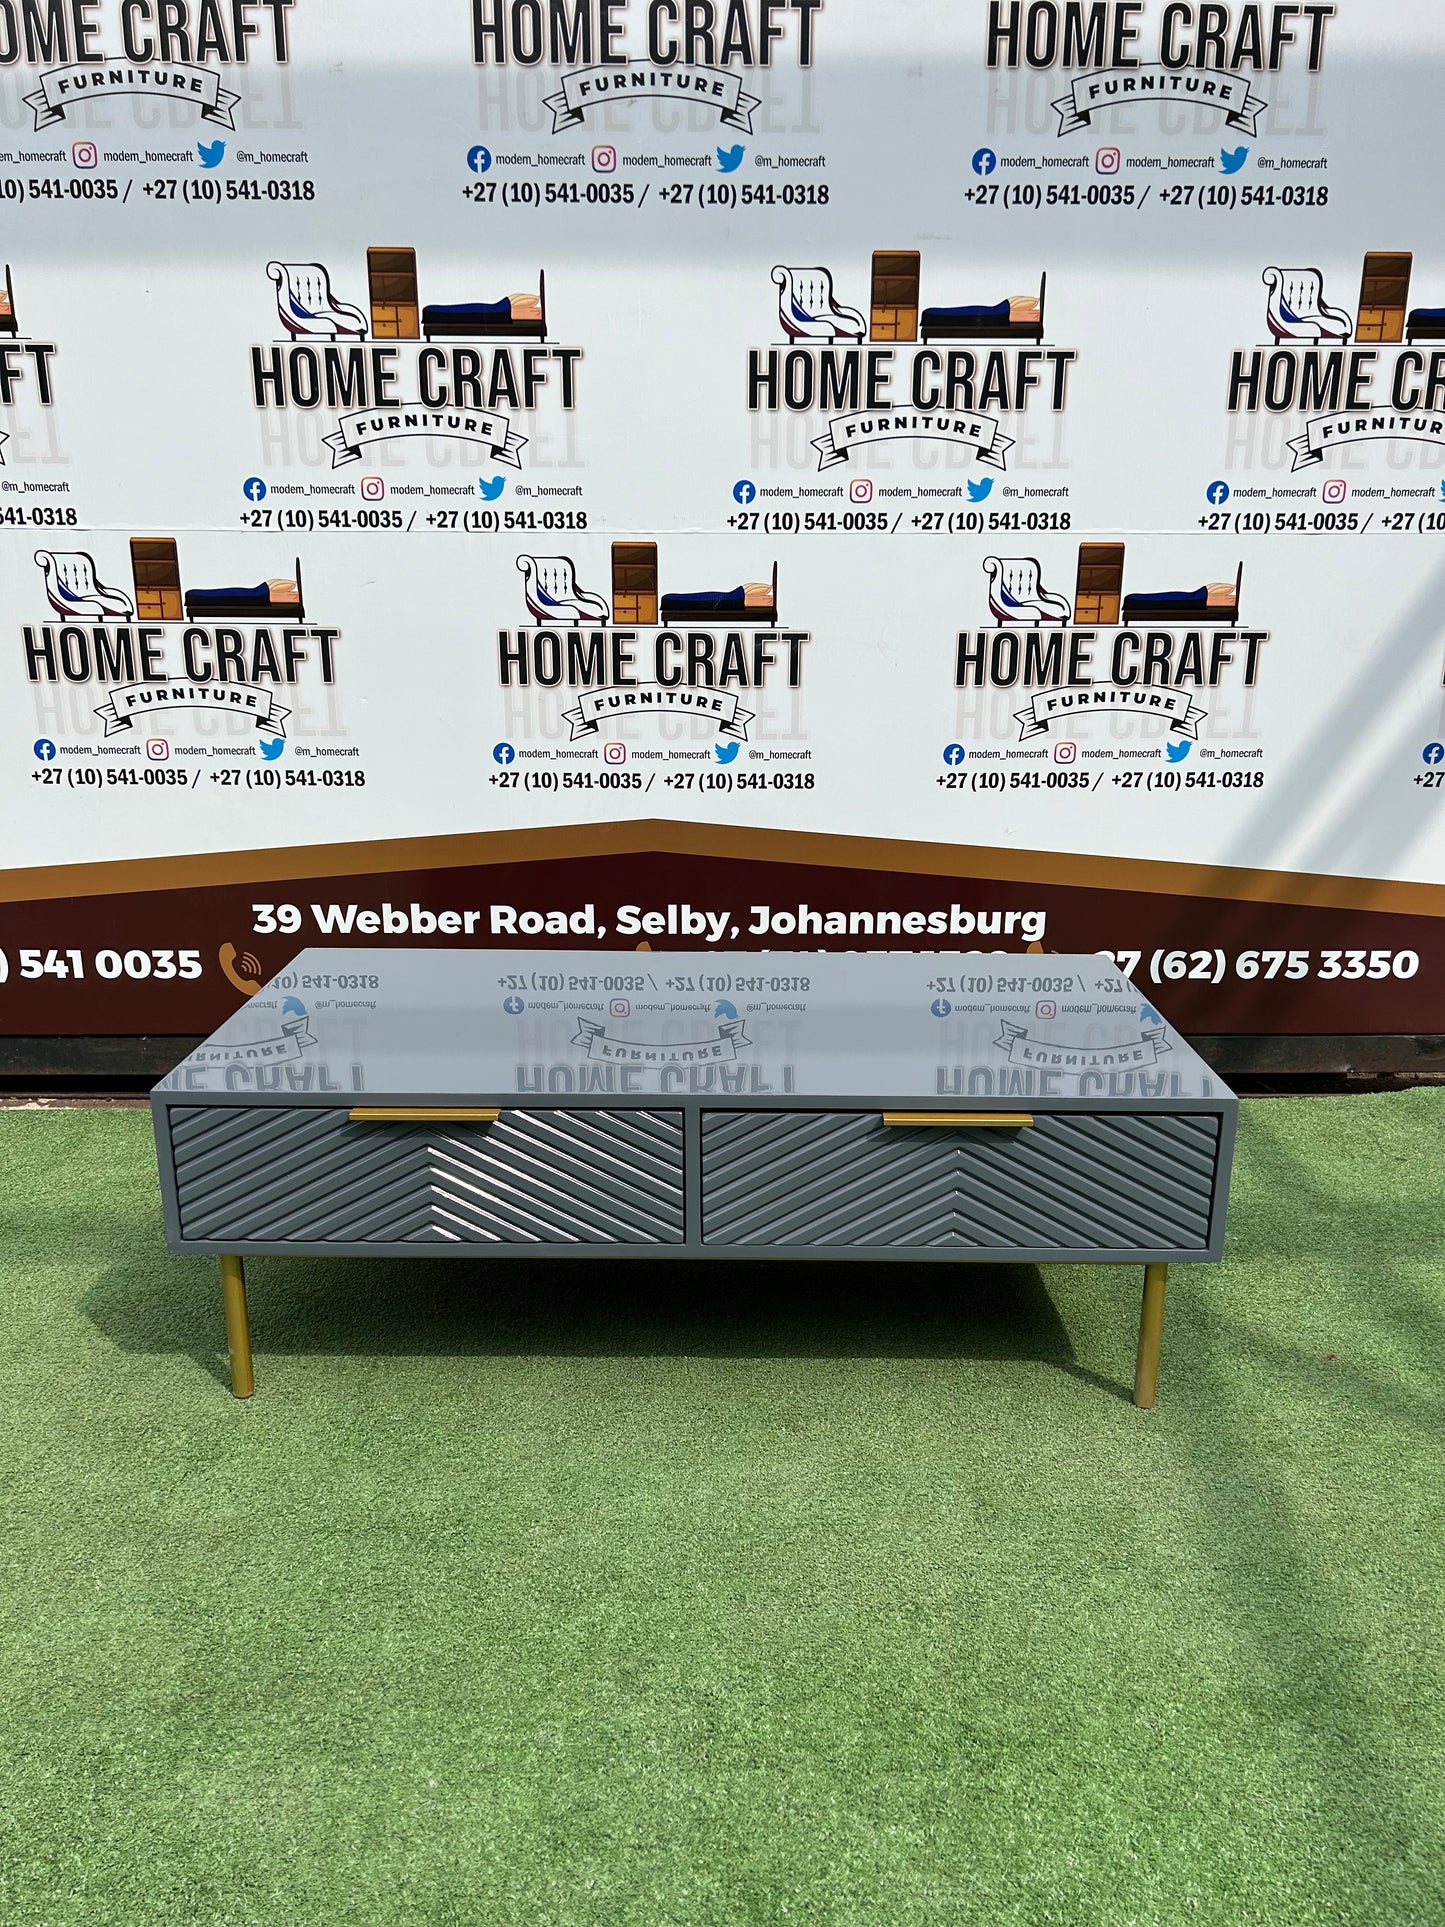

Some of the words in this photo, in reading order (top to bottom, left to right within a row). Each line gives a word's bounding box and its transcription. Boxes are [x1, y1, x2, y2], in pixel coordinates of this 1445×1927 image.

[0, 0, 104, 63] OME
[122, 0, 291, 63] CRAFT
[474, 0, 627, 64] HOME
[648, 0, 821, 66] CRAFT
[987, 2, 1142, 67] HOME
[1160, 2, 1334, 70] CRAFT
[58, 69, 204, 94] FURNITURE
[579, 72, 725, 97] FURNITURE
[1089, 75, 1233, 99] FURNITURE
[237, 151, 308, 164] @m_homecraft
[755, 155, 825, 169] @m_homecraft
[1258, 157, 1327, 170] @m_homecraft
[0, 179, 24, 203] 10)
[29, 179, 118, 199] 541-0035
[143, 179, 177, 199] +27
[183, 180, 221, 204] (10)
[226, 180, 315, 200] 541-0318
[462, 182, 496, 202] +27
[502, 183, 540, 207] (10)
[545, 183, 634, 203] 541-0035
[659, 184, 693, 203] +27
[699, 184, 736, 209] (10)
[741, 185, 829, 205] 541-0318
[965, 185, 999, 204] +27
[1004, 185, 1041, 209] (10)
[1046, 185, 1134, 205] 541-0035
[1160, 185, 1194, 205] +27
[1199, 186, 1236, 210] (10)
[1241, 186, 1328, 206] 541-0318
[251, 347, 401, 407] HOME
[418, 348, 582, 408] CRAFT
[748, 350, 894, 409] HOME
[912, 351, 1076, 411] CRAFT
[1228, 351, 1377, 410] HOME
[356, 414, 493, 436] FURNITURE
[845, 416, 981, 438] FURNITURE
[1323, 417, 1445, 438] FURNITUR
[2, 481, 69, 493] @m_homecraft
[516, 485, 582, 497] @m_homecraft
[1003, 487, 1068, 498] @m_homecraft
[240, 510, 272, 527] +27
[278, 510, 313, 530] (10)
[319, 510, 402, 528] 541-0035
[426, 511, 458, 528] +27
[464, 511, 499, 530] (10)
[504, 511, 587, 529] 541-0318
[727, 513, 759, 529] +27
[764, 513, 799, 534] (10)
[805, 513, 887, 530] 541-0035
[912, 513, 944, 534] +27
[949, 513, 984, 533] (10)
[989, 513, 1070, 530] 541-0318
[1198, 513, 1231, 530] +27
[1235, 513, 1270, 533] (10)
[1275, 513, 1358, 530] 541-0035
[1382, 513, 1415, 530] +27
[22, 627, 168, 681] HOME
[184, 628, 339, 684] CRAFT
[498, 631, 638, 685] HOME
[654, 632, 809, 687] CRAFT
[956, 632, 1097, 685] HOME
[1112, 632, 1268, 687] CRAFT
[126, 688, 257, 707] FURNITURE
[594, 692, 722, 712] FURNITURE
[1048, 691, 1177, 711] FURNITURE
[295, 747, 359, 757] @m_homecraft
[749, 750, 811, 761] @m_homecraft
[1200, 749, 1263, 759] @m_homecraft
[32, 768, 62, 784] +27
[68, 769, 102, 788] (10)
[107, 769, 187, 785] 541-0035
[210, 770, 240, 785] +27
[247, 770, 281, 789] (10)
[286, 770, 365, 786] 541-0318
[489, 772, 519, 787] +27
[525, 772, 558, 791] (10)
[563, 773, 641, 788] 541-0035
[664, 773, 694, 789] +27
[699, 774, 732, 792] (10)
[737, 773, 814, 789] 541-0318
[937, 773, 967, 788] +27
[972, 773, 1005, 792] (10)
[1010, 772, 1089, 788] 541-0035
[1112, 772, 1143, 787] +27
[1147, 772, 1181, 791] (10)
[1185, 772, 1263, 787] 541-0318
[1414, 772, 1445, 787] +27
[252, 904, 302, 935] 39
[313, 904, 481, 935] Webber
[490, 904, 606, 938] Road,
[616, 905, 739, 942] Selby,
[748, 905, 1047, 942] Johannesburg
[20, 949, 84, 980] 541
[96, 949, 201, 980] 0035
[1149, 949, 1226, 983] (62)
[1235, 950, 1309, 980] 675
[1319, 950, 1419, 980] 3350
